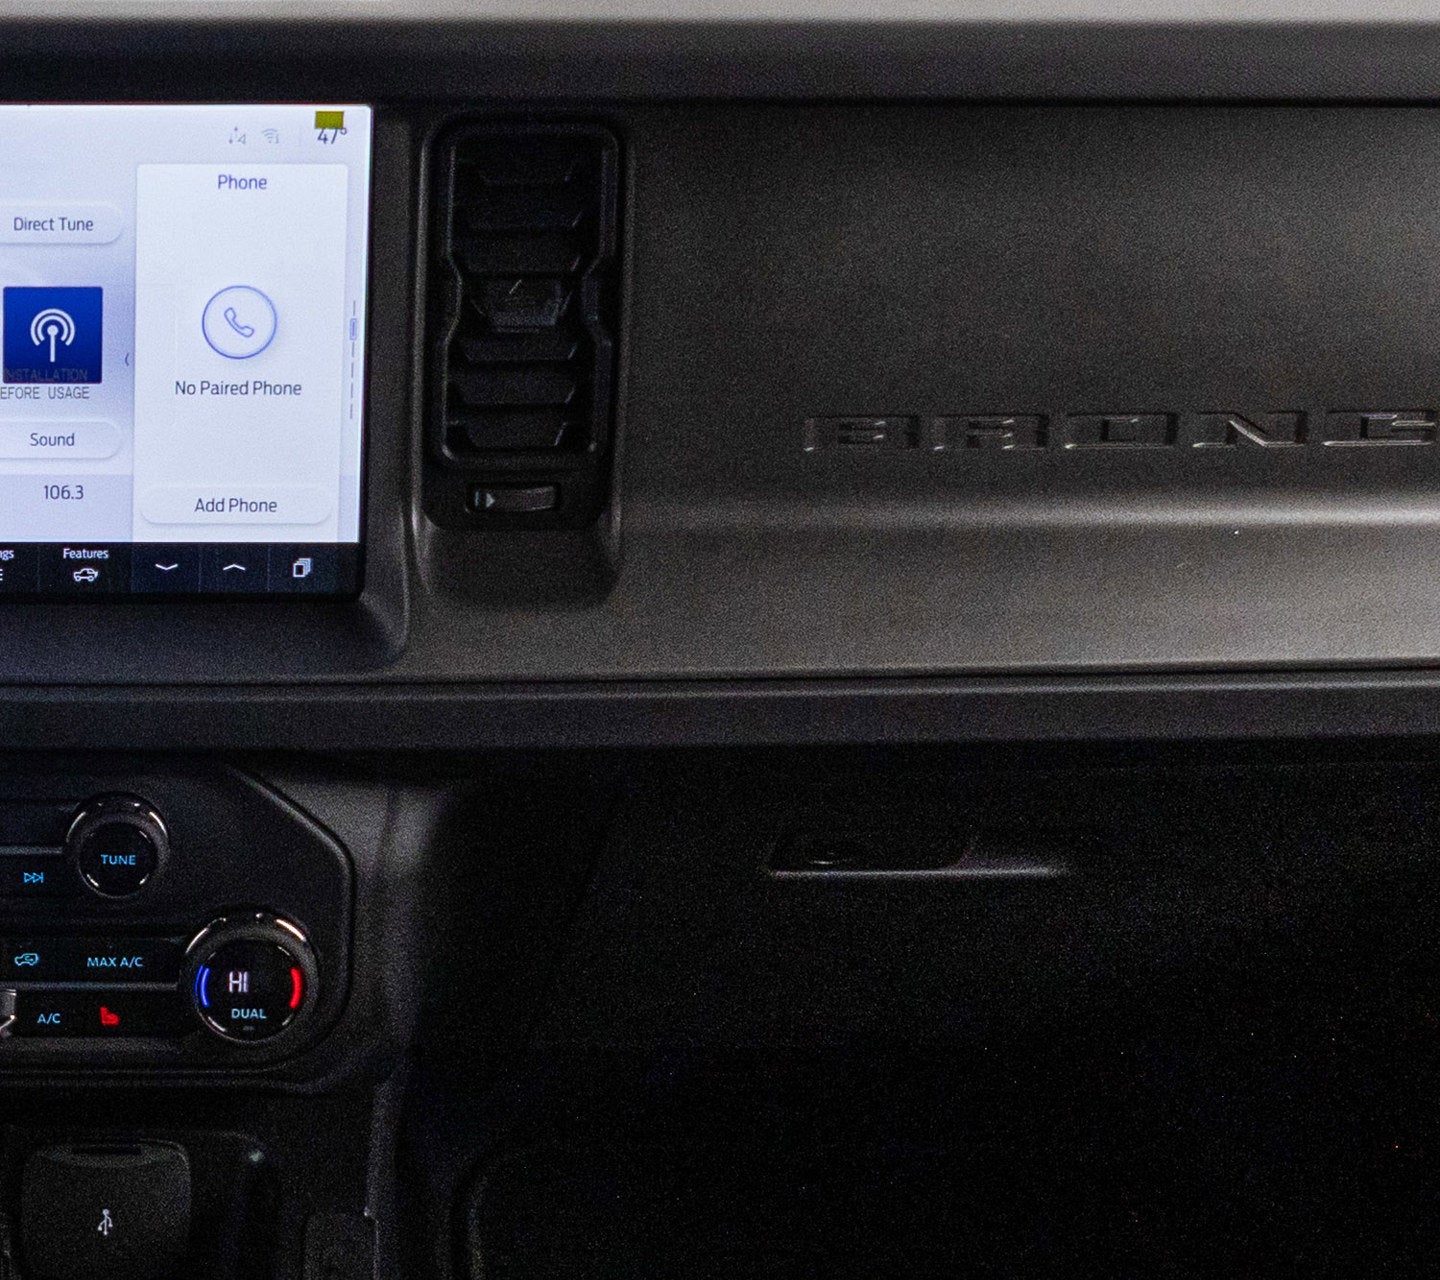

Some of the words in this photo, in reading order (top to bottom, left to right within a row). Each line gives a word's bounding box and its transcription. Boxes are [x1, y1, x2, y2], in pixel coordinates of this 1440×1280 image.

[217, 173, 268, 190] Phone
[13, 216, 56, 232] Direct
[58, 216, 95, 232] Tune
[47, 387, 90, 400] USAGE
[175, 380, 197, 396] No
[200, 380, 247, 396] Paired
[250, 380, 303, 396] Phone
[29, 432, 76, 447] Sound
[43, 484, 85, 501] 106.3
[194, 497, 224, 513] Add
[228, 497, 278, 513] Phone
[62, 547, 109, 559] Features
[101, 854, 136, 866] TUNE
[87, 956, 116, 968] MAX
[119, 956, 143, 969] A/C
[228, 971, 248, 993] HI
[37, 1012, 61, 1025] A/C
[231, 1007, 267, 1020] DUAL
